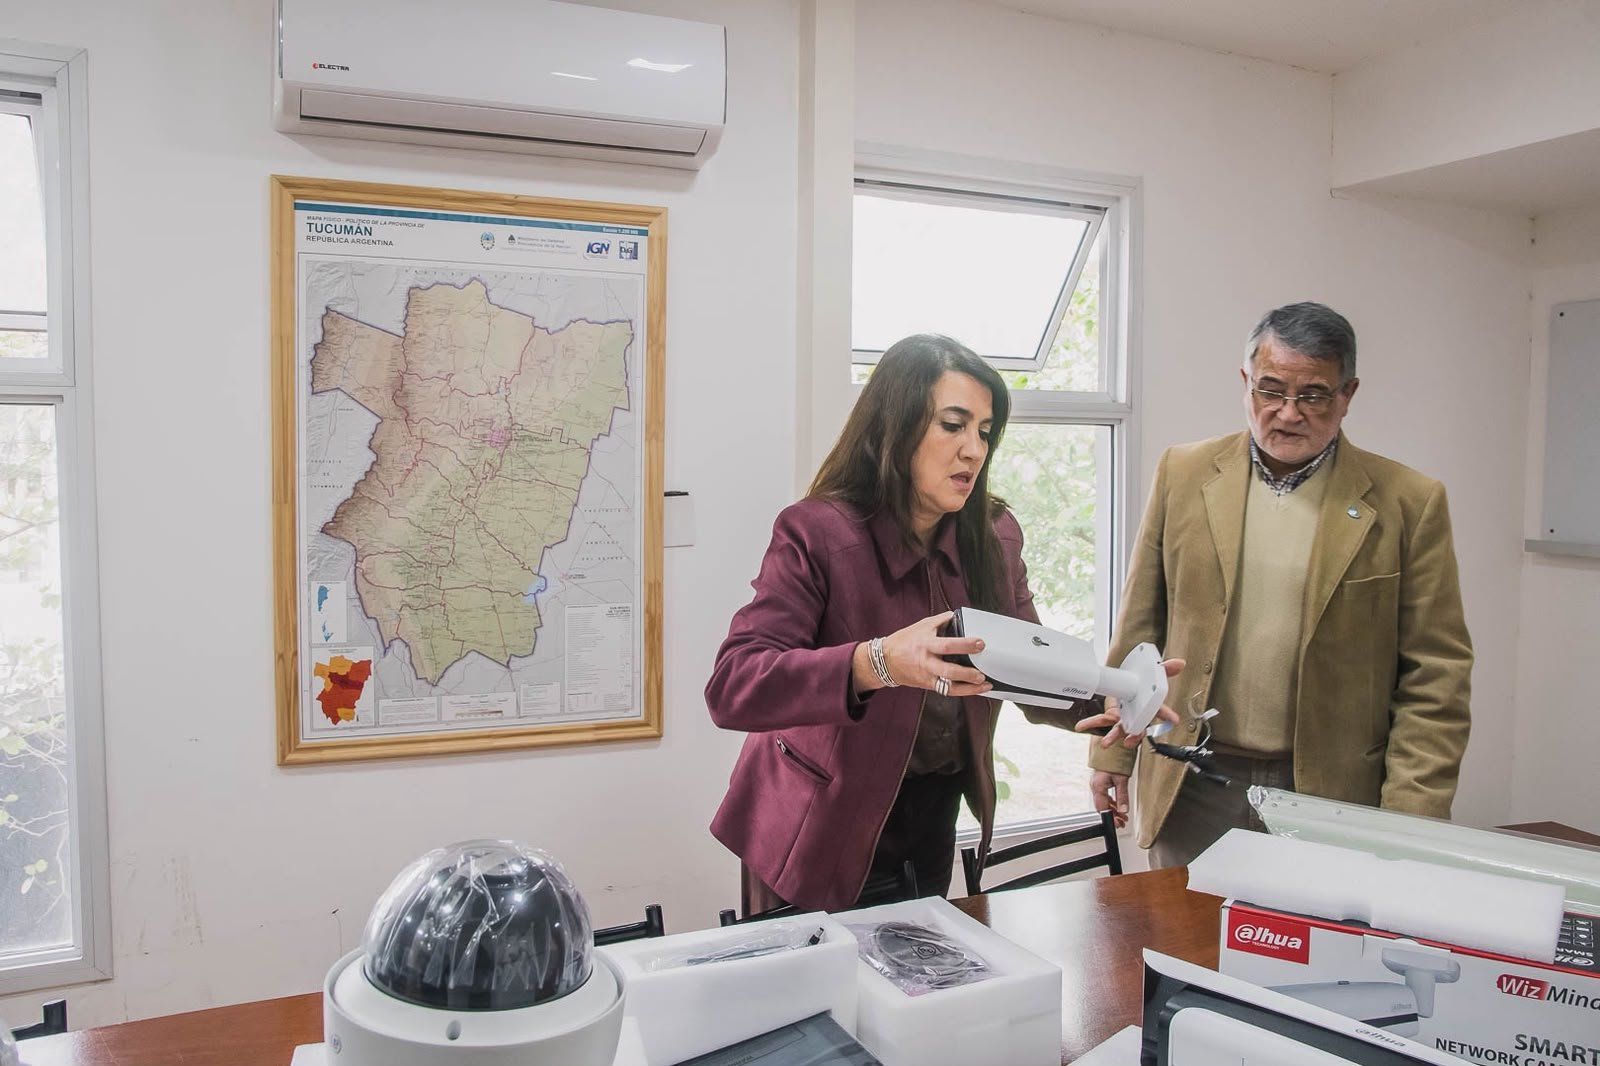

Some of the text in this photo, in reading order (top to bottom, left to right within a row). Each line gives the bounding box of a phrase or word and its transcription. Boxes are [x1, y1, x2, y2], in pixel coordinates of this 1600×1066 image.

[306, 223, 373, 236] TUCUMÁN
[586, 242, 610, 255] IGN
[1435, 1037, 1520, 1066] NETWORK
